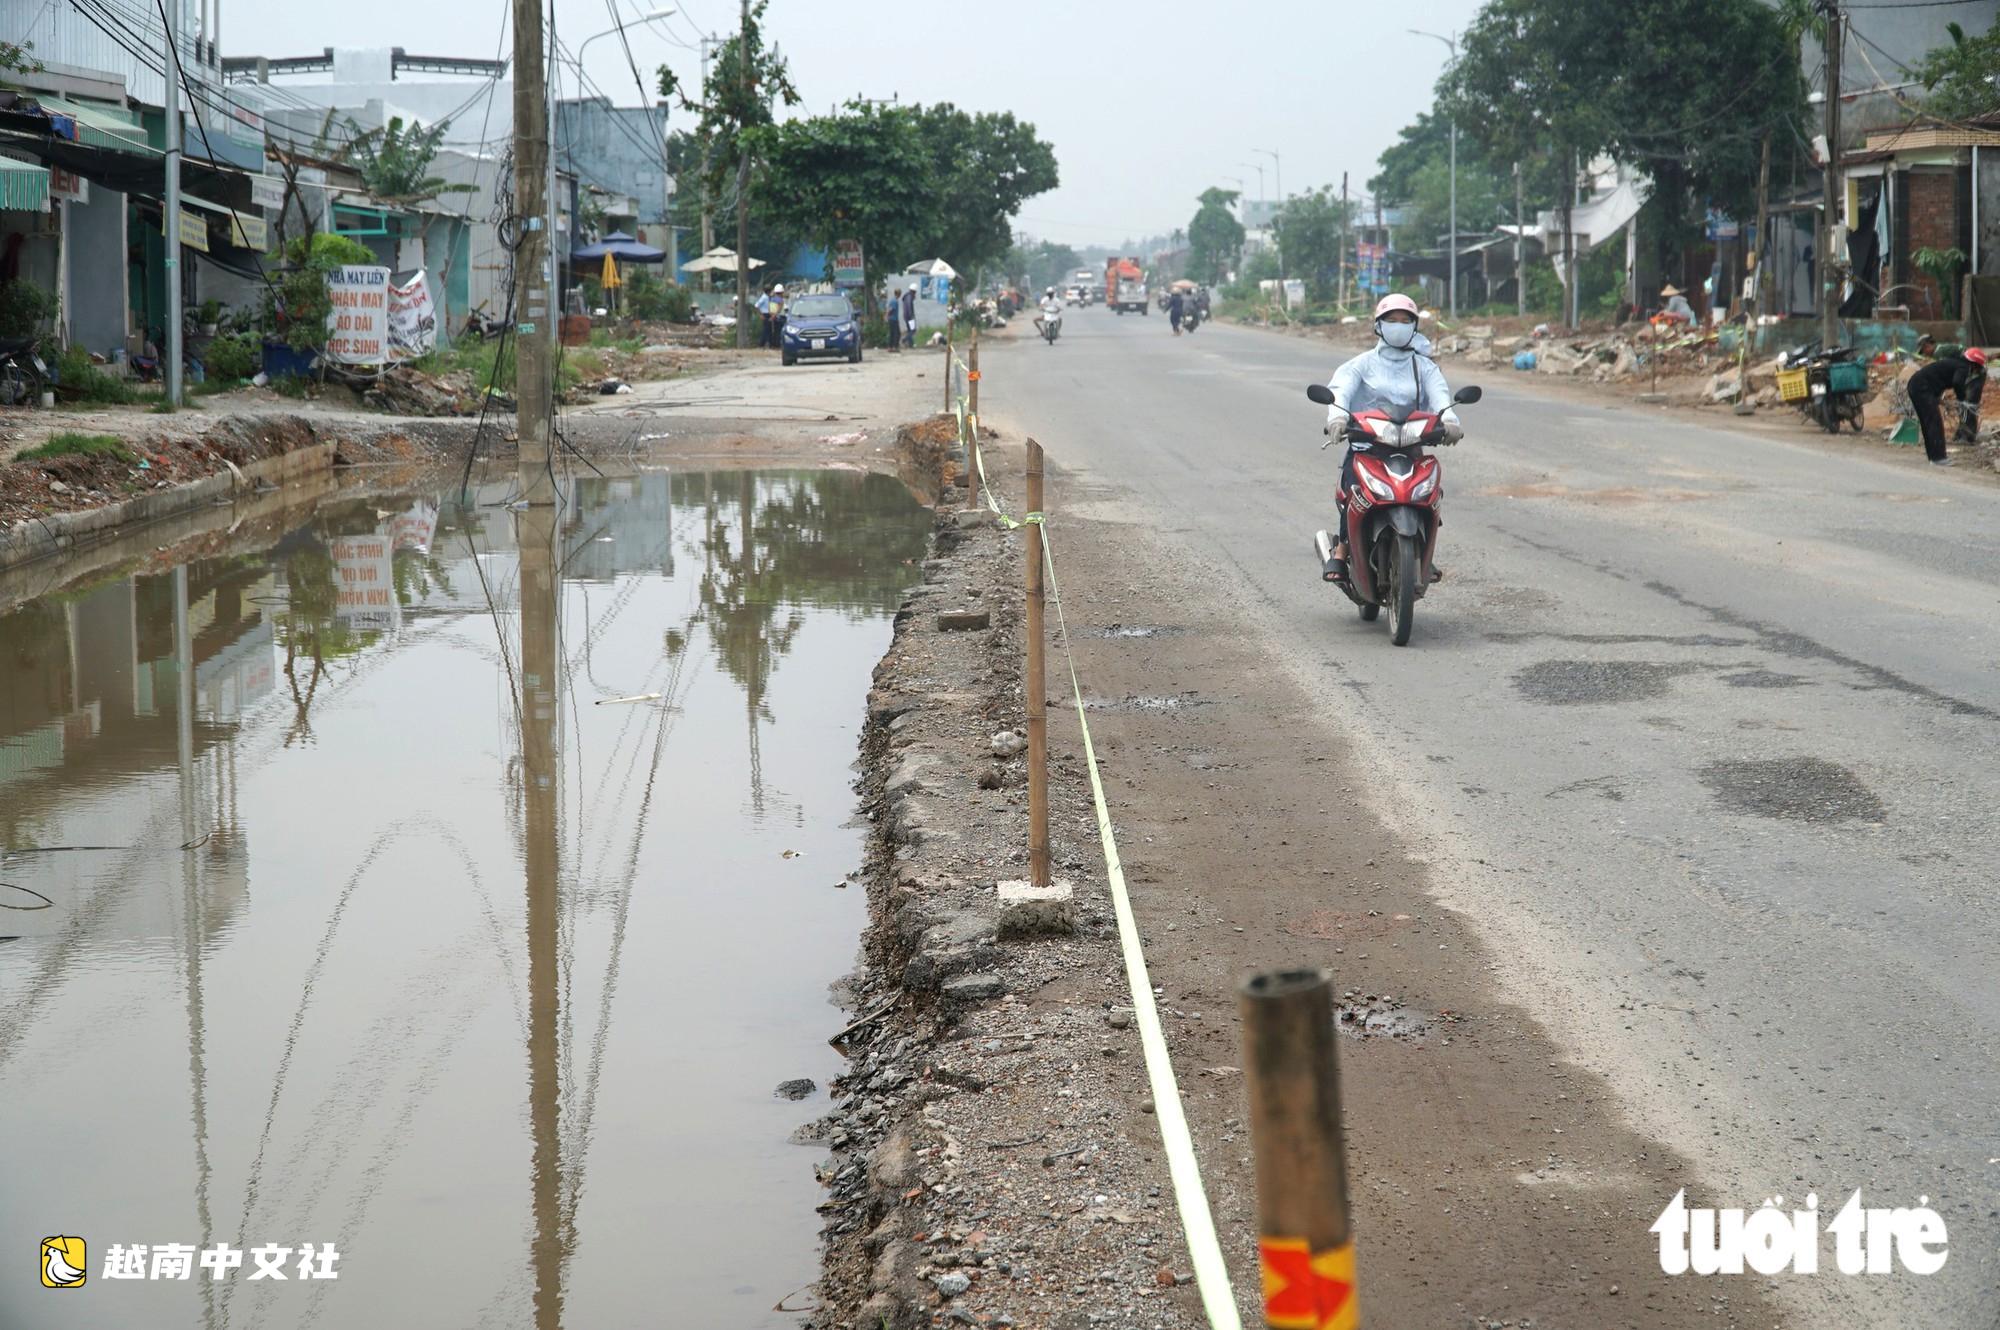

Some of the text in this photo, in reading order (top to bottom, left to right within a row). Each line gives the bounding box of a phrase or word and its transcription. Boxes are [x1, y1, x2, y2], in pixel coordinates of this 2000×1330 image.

[347, 271, 367, 285] MAY
[361, 292, 384, 309] MAY
[328, 338, 350, 356] HỌC
[352, 339, 380, 355] SINH
